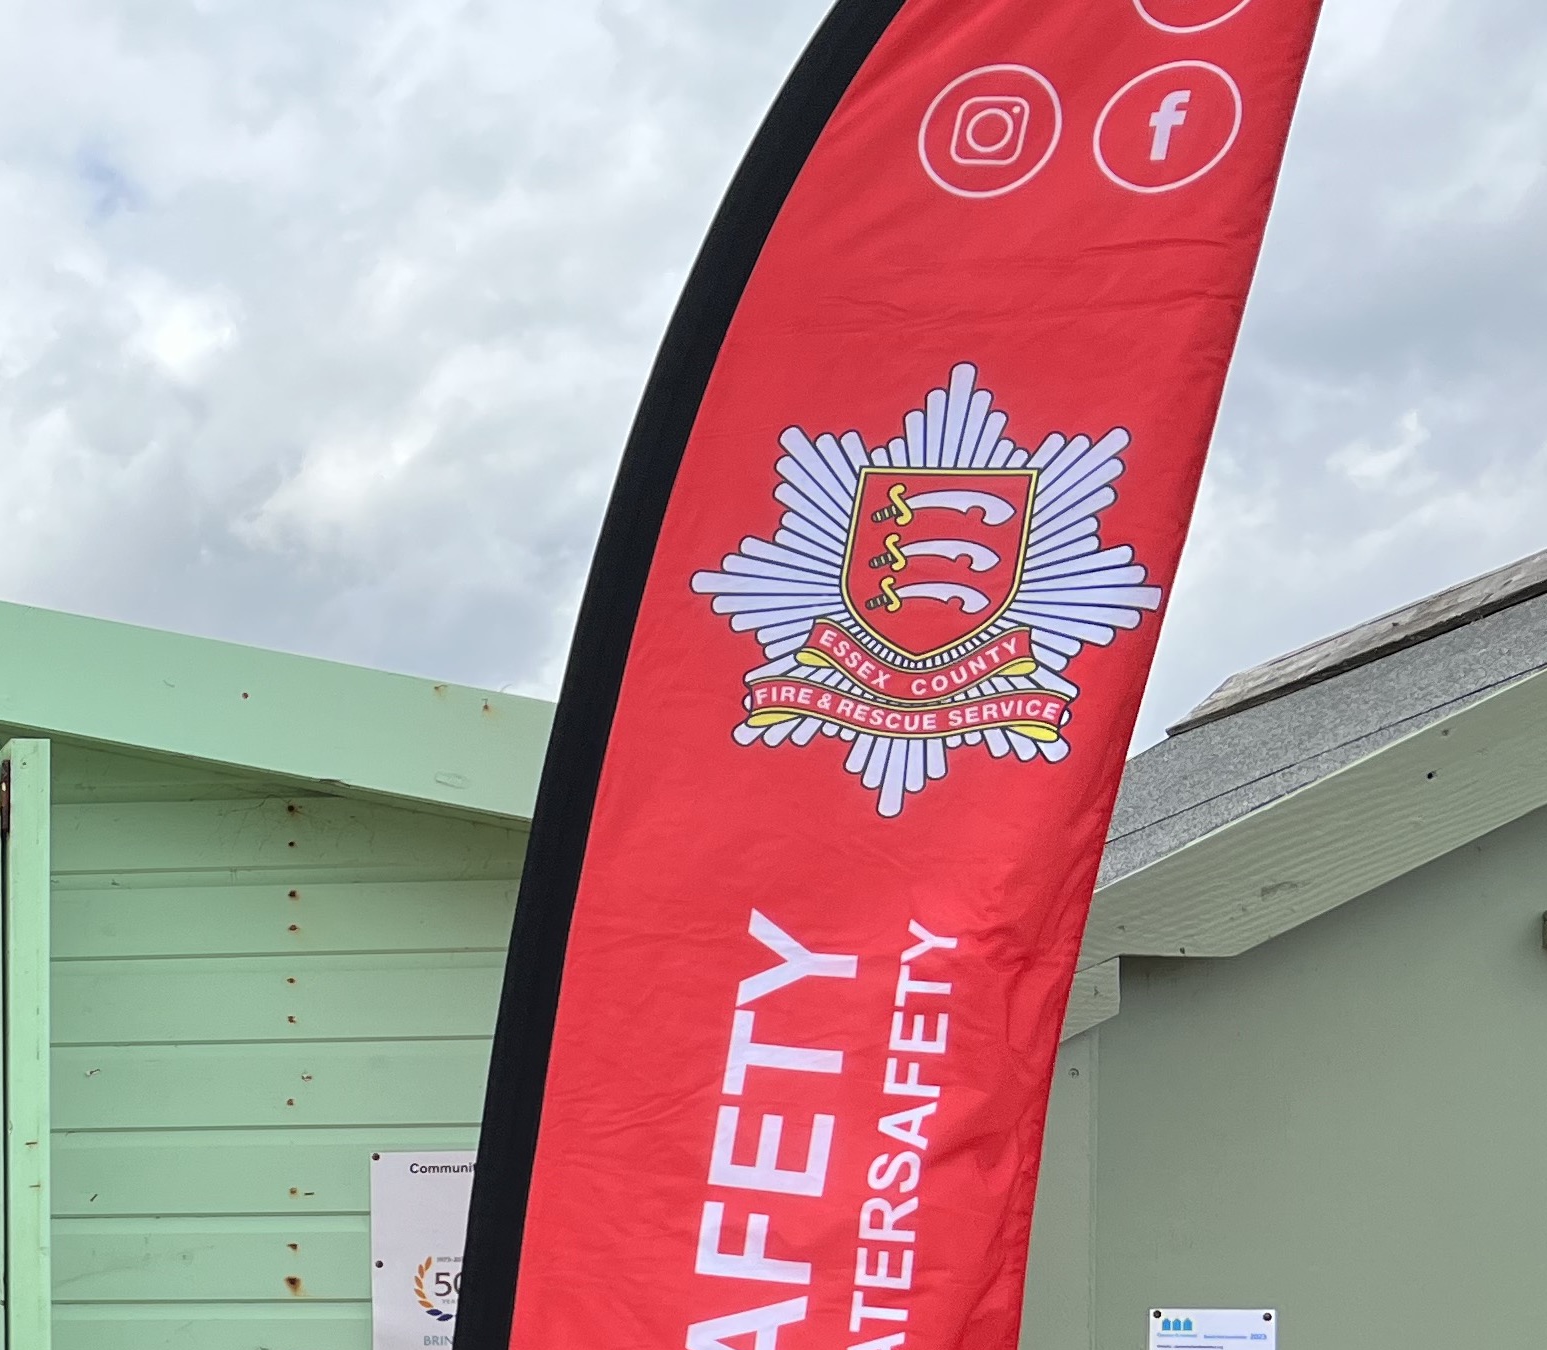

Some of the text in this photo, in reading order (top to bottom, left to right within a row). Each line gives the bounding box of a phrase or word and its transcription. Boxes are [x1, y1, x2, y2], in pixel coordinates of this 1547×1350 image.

[819, 629, 1019, 697] ESSEX COUNTY
[754, 685, 1061, 732] FIRE & RESCUE SERVICE
[423, 1335, 453, 1346] BRIN
